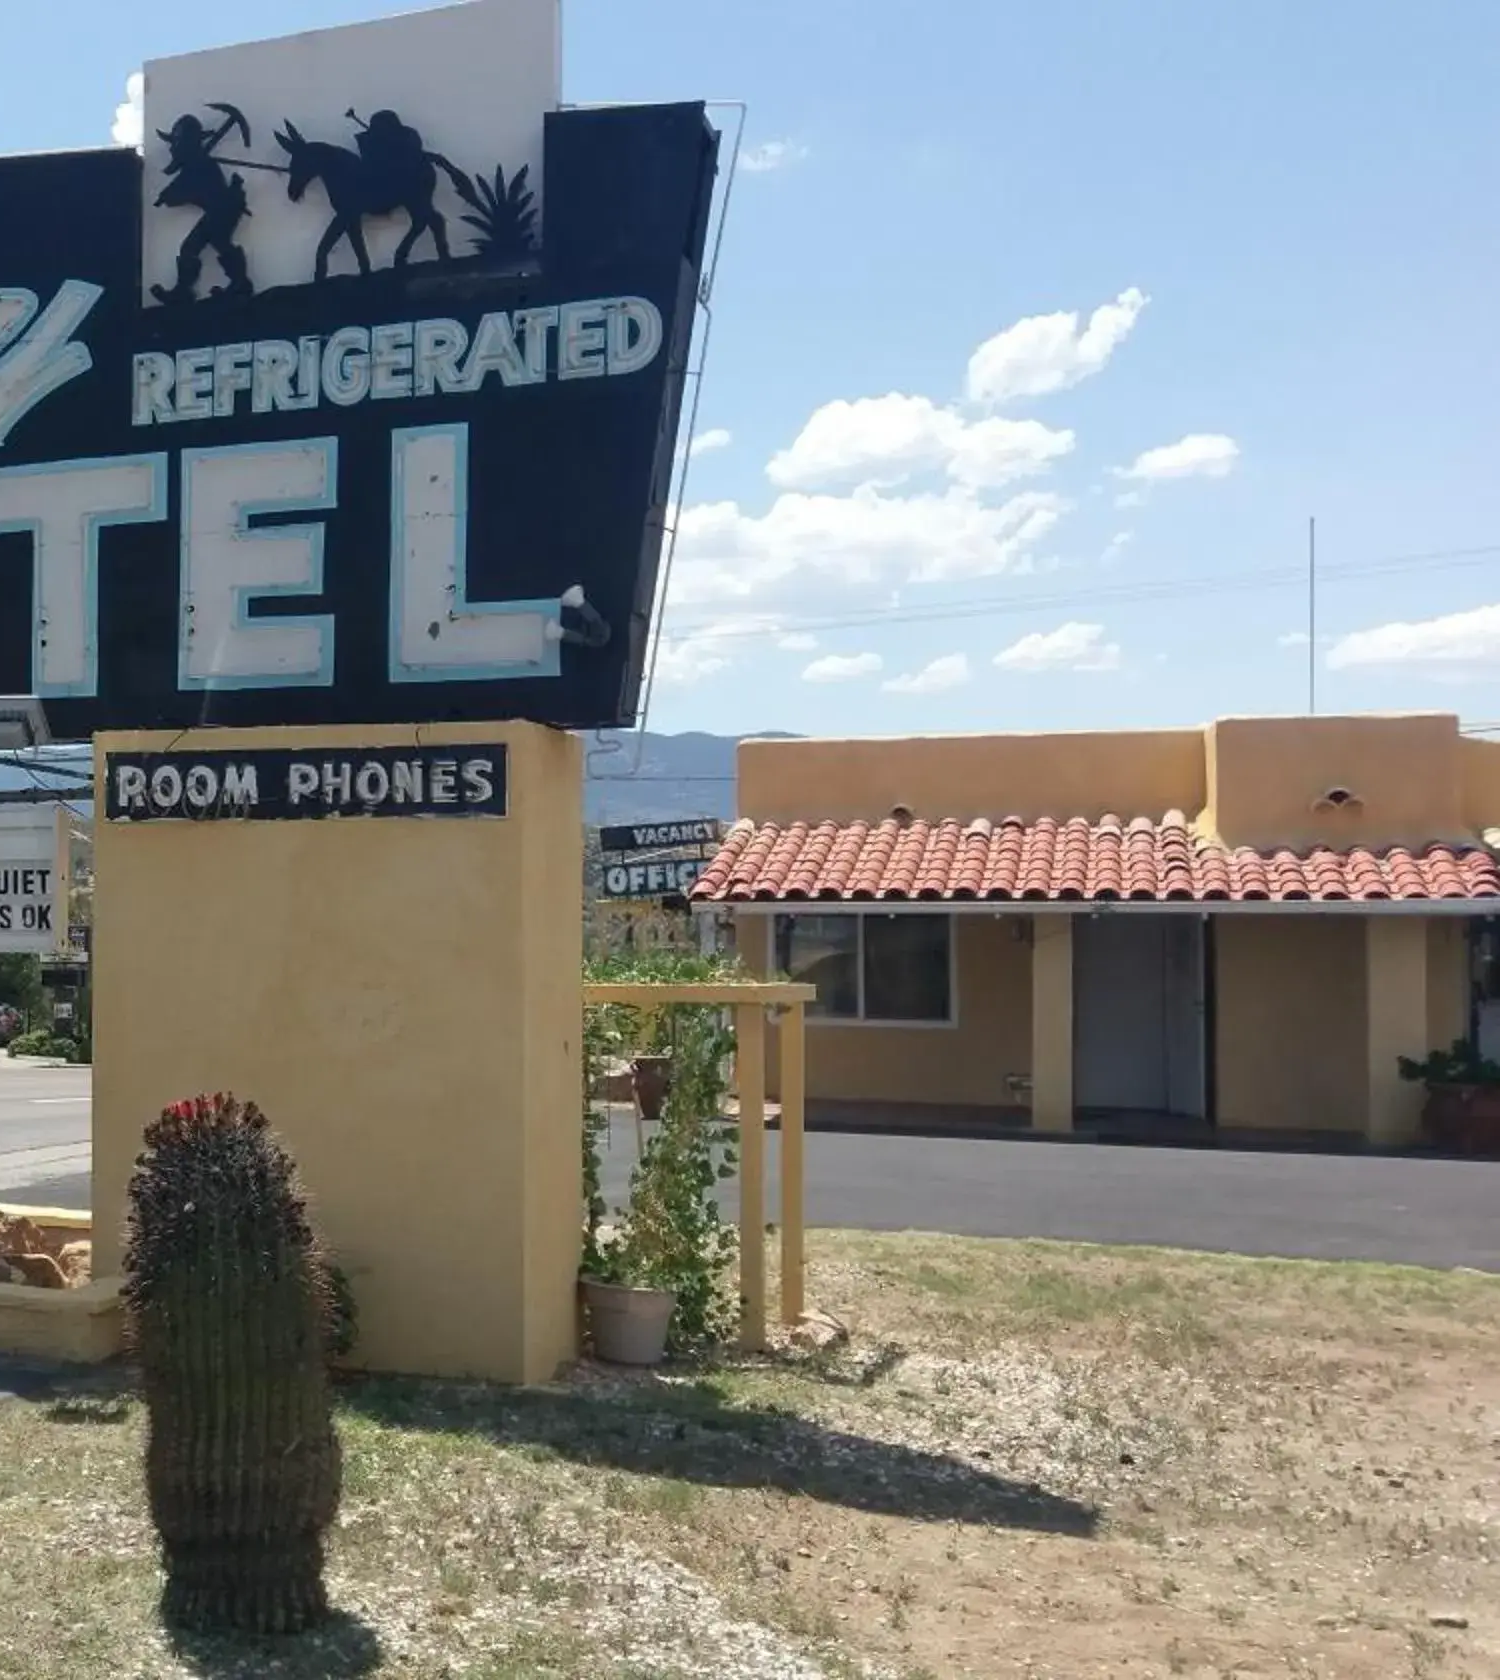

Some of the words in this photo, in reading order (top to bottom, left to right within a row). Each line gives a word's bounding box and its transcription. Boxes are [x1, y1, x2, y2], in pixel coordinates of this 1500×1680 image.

[131, 296, 663, 427] REFRIGERATED
[117, 763, 259, 808] ROOM
[287, 759, 495, 805] PHONES
[633, 823, 714, 845] VACANCY
[21, 904, 51, 929] OK
